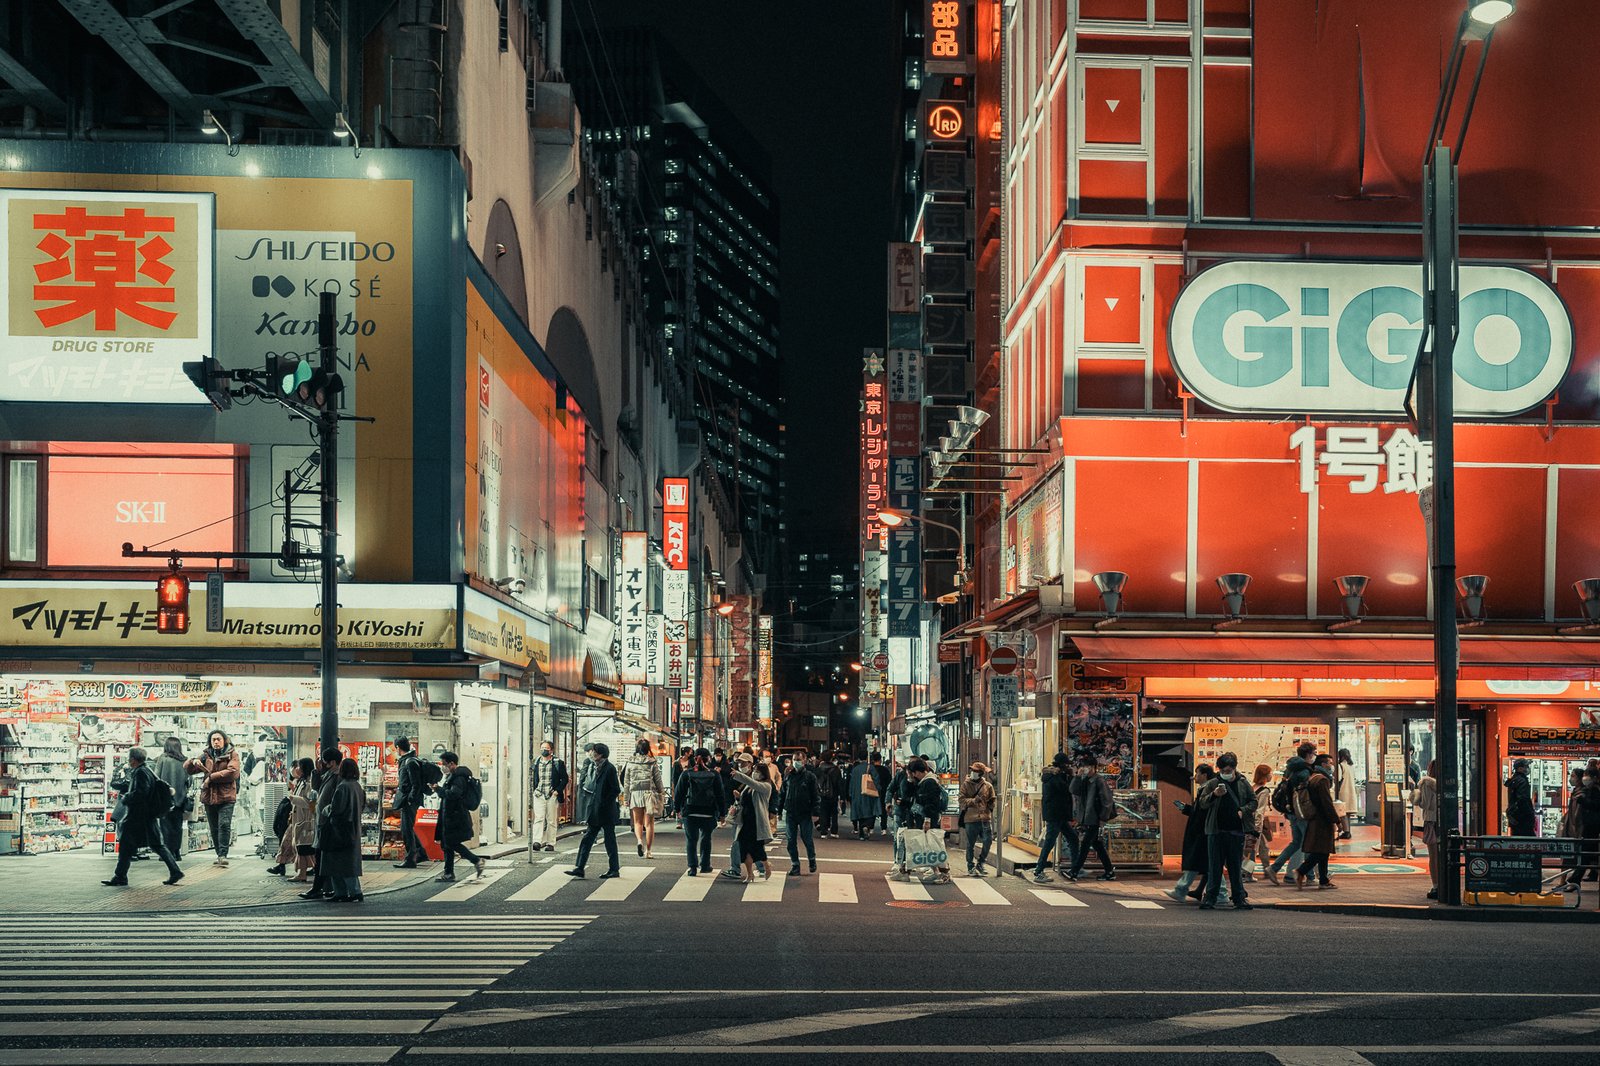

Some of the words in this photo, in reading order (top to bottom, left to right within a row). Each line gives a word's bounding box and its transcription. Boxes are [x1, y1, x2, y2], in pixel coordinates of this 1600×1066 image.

[932, 1, 959, 56] 部品
[235, 238, 396, 262] SHISEIDO
[33, 206, 178, 332] 薬
[304, 275, 382, 299] KOSÉ
[255, 311, 377, 338] Kanbo
[51, 340, 98, 353] DRUG
[102, 340, 155, 354] STORE
[1192, 283, 1552, 392] GiGO
[115, 501, 166, 524] SK-II
[668, 519, 684, 564] KFC
[12, 600, 192, 639] マツモトキヨ
[222, 618, 343, 637] Matsumoo
[347, 620, 425, 637] KiYoshi
[626, 567, 643, 669] オヤイデ電気
[668, 645, 683, 687] お弁当
[260, 700, 292, 713] Free
[912, 850, 948, 865] GiGO
[1490, 860, 1534, 869] 路上喫煙禁止
